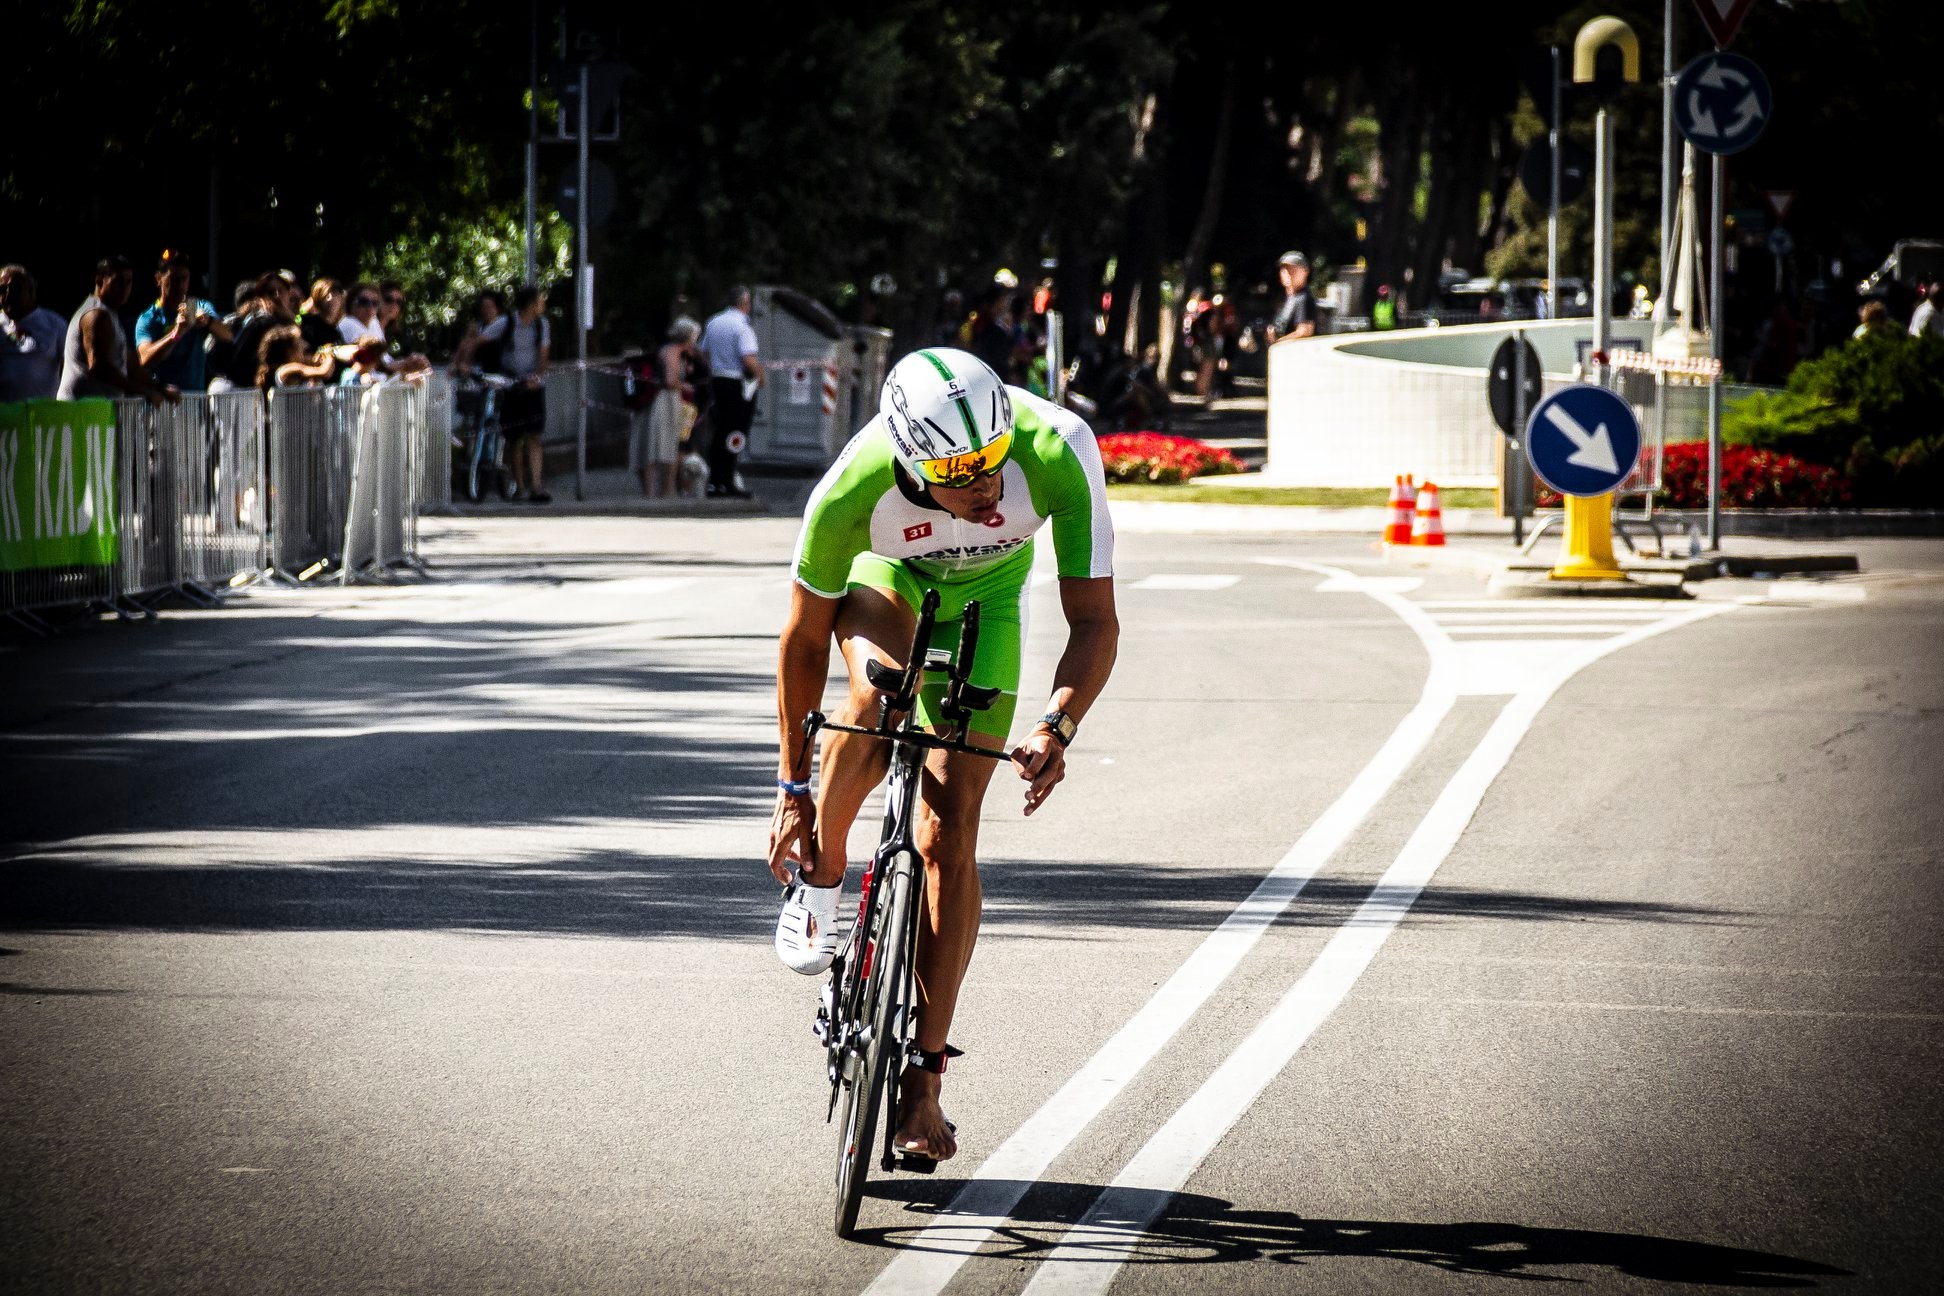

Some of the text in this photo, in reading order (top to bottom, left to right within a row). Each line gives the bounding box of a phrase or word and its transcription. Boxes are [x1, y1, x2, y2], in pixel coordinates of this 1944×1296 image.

[949, 381, 958, 390] 6
[887, 414, 913, 458] pewag
[909, 525, 928, 539] 3T
